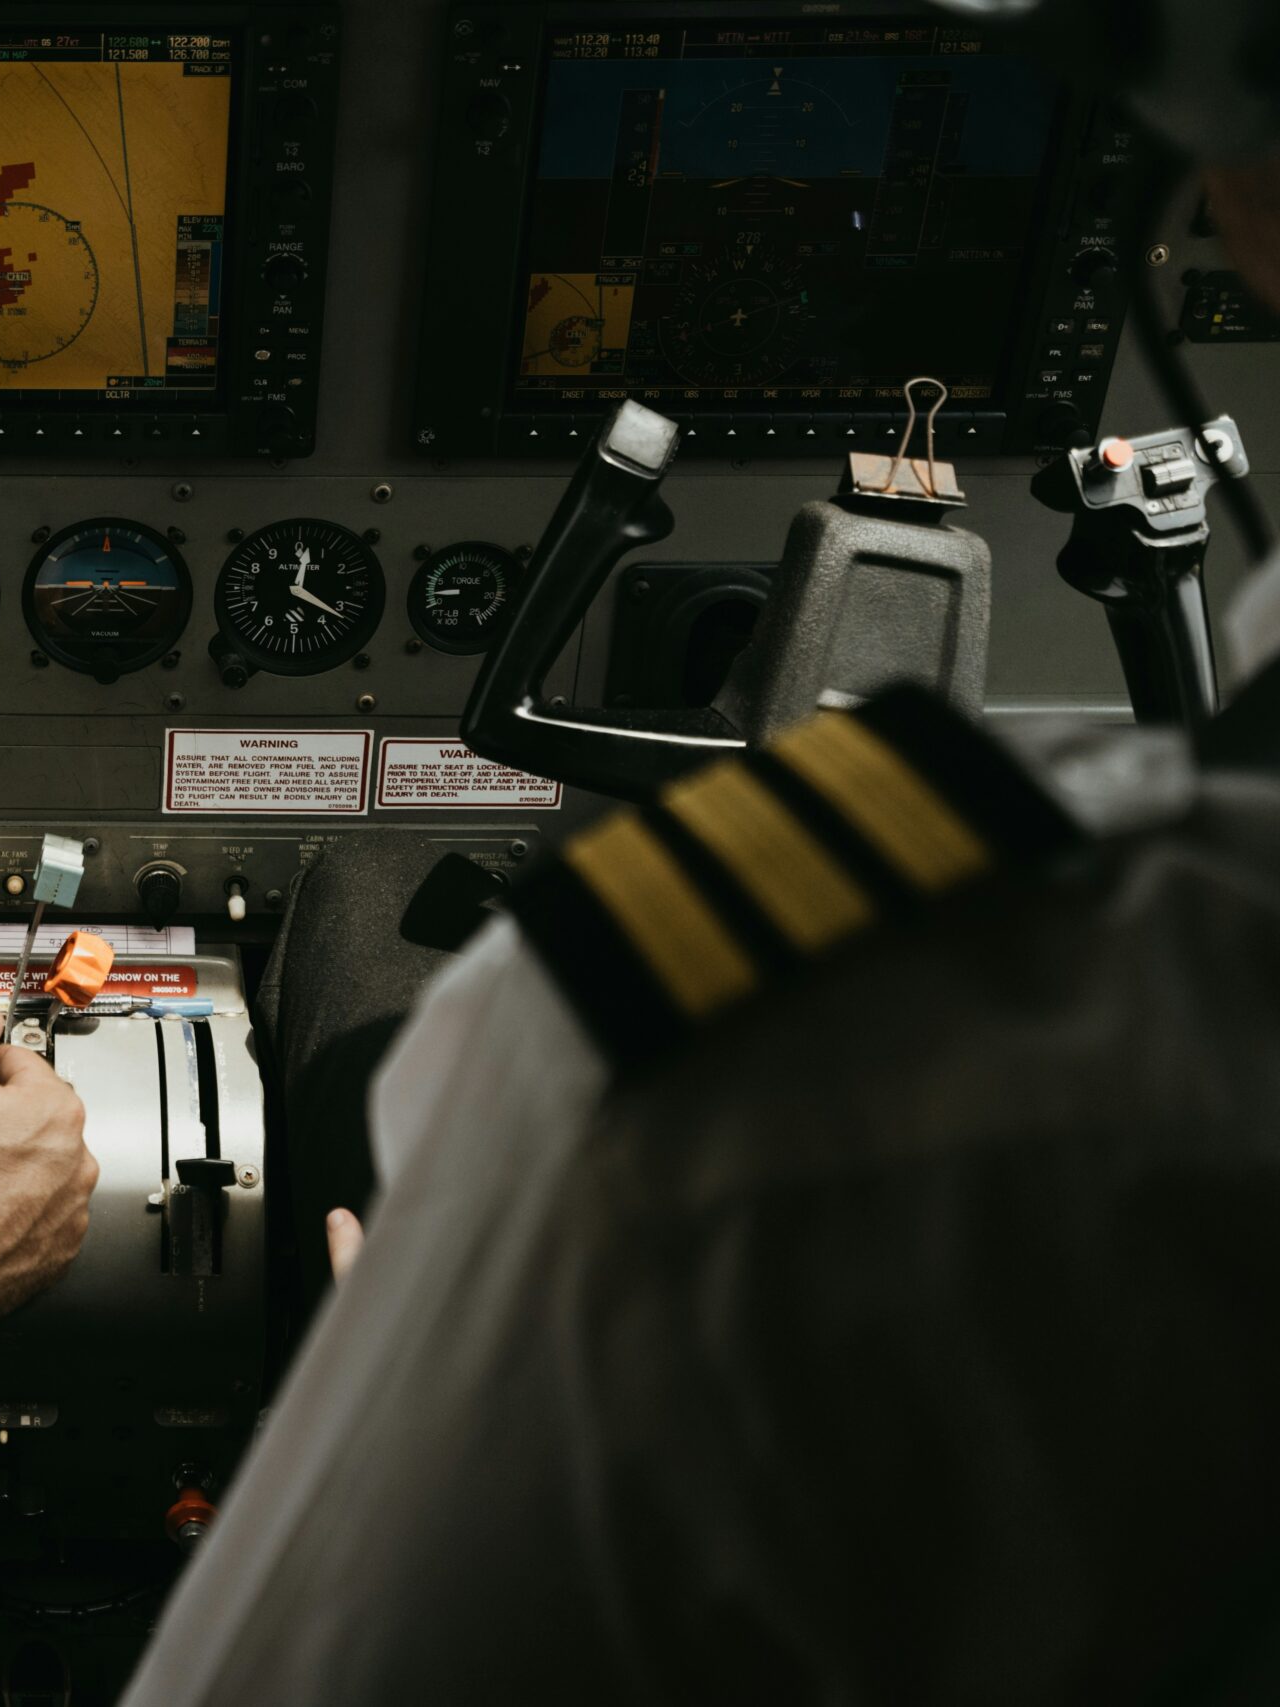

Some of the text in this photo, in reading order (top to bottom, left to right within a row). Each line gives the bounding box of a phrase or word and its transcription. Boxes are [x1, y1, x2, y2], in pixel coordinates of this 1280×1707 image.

[169, 37, 210, 47] 122.200
[575, 34, 660, 45] 112.20 113.40
[108, 50, 148, 60] 121.500
[169, 50, 209, 60] 126.700
[283, 80, 307, 88] COM
[479, 79, 501, 88] NAV
[276, 163, 304, 172] BARO
[269, 243, 303, 251] RANGE
[106, 391, 130, 399] DCLTR
[561, 391, 584, 399] INSET
[598, 391, 627, 399] SENSOR
[1053, 391, 1072, 399] FMS
[269, 549, 278, 559] 9
[251, 563, 260, 573] 8
[337, 563, 346, 574] 2
[251, 601, 258, 612] 7
[336, 601, 344, 611] 3
[265, 616, 274, 626] 6
[317, 615, 326, 624] 4
[290, 624, 298, 634] 5
[240, 740, 298, 748] WARNING
[31, 972, 48, 981] WIT
[105, 973, 142, 982] T/SNOW
[145, 973, 157, 982] ON
[160, 974, 180, 982] THE
